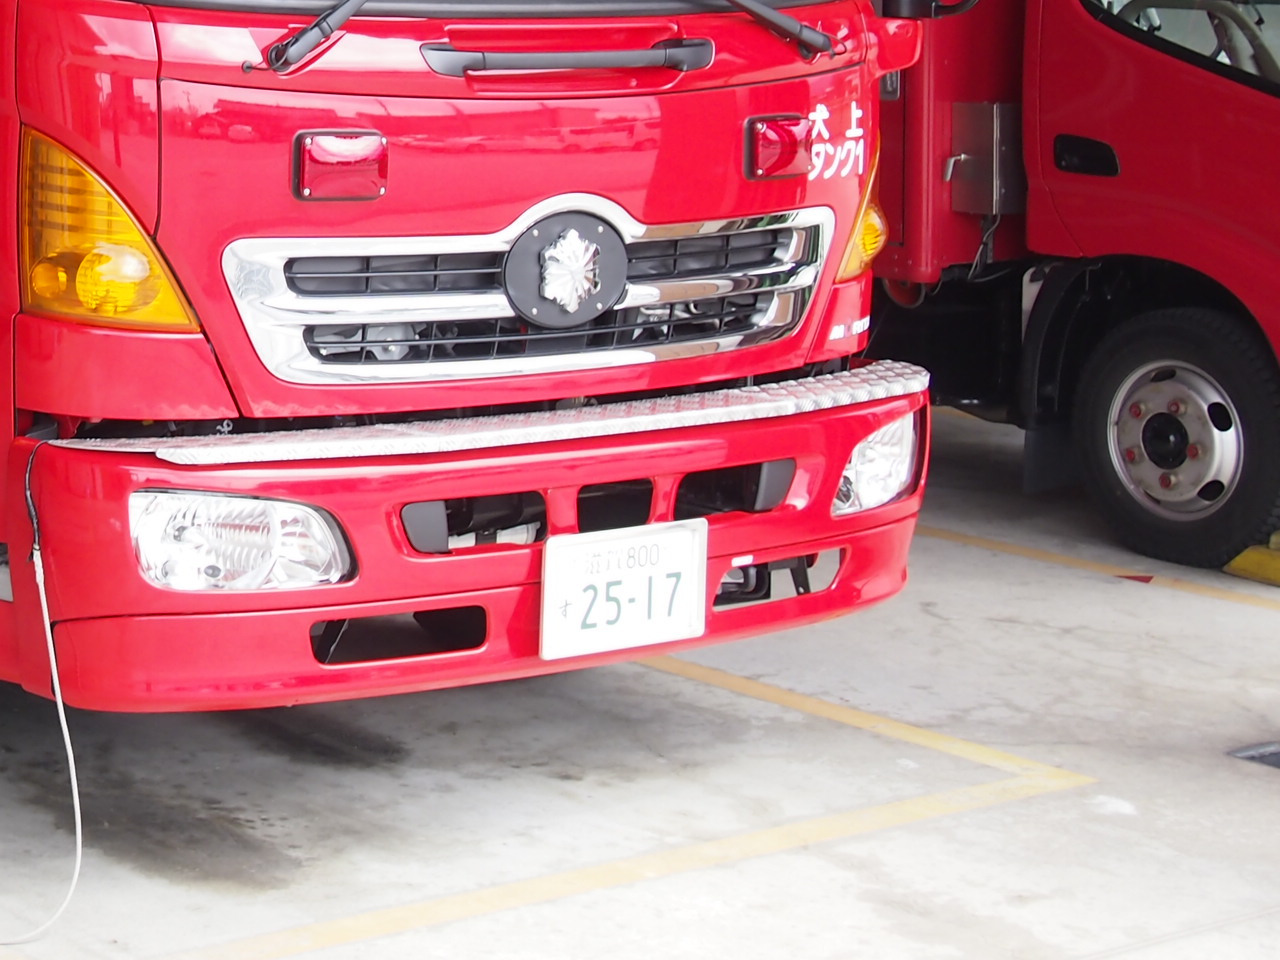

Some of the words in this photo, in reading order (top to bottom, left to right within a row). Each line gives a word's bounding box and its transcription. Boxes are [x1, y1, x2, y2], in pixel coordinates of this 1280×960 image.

[807, 138, 864, 181] タンク1
[580, 571, 683, 631] 25-17
